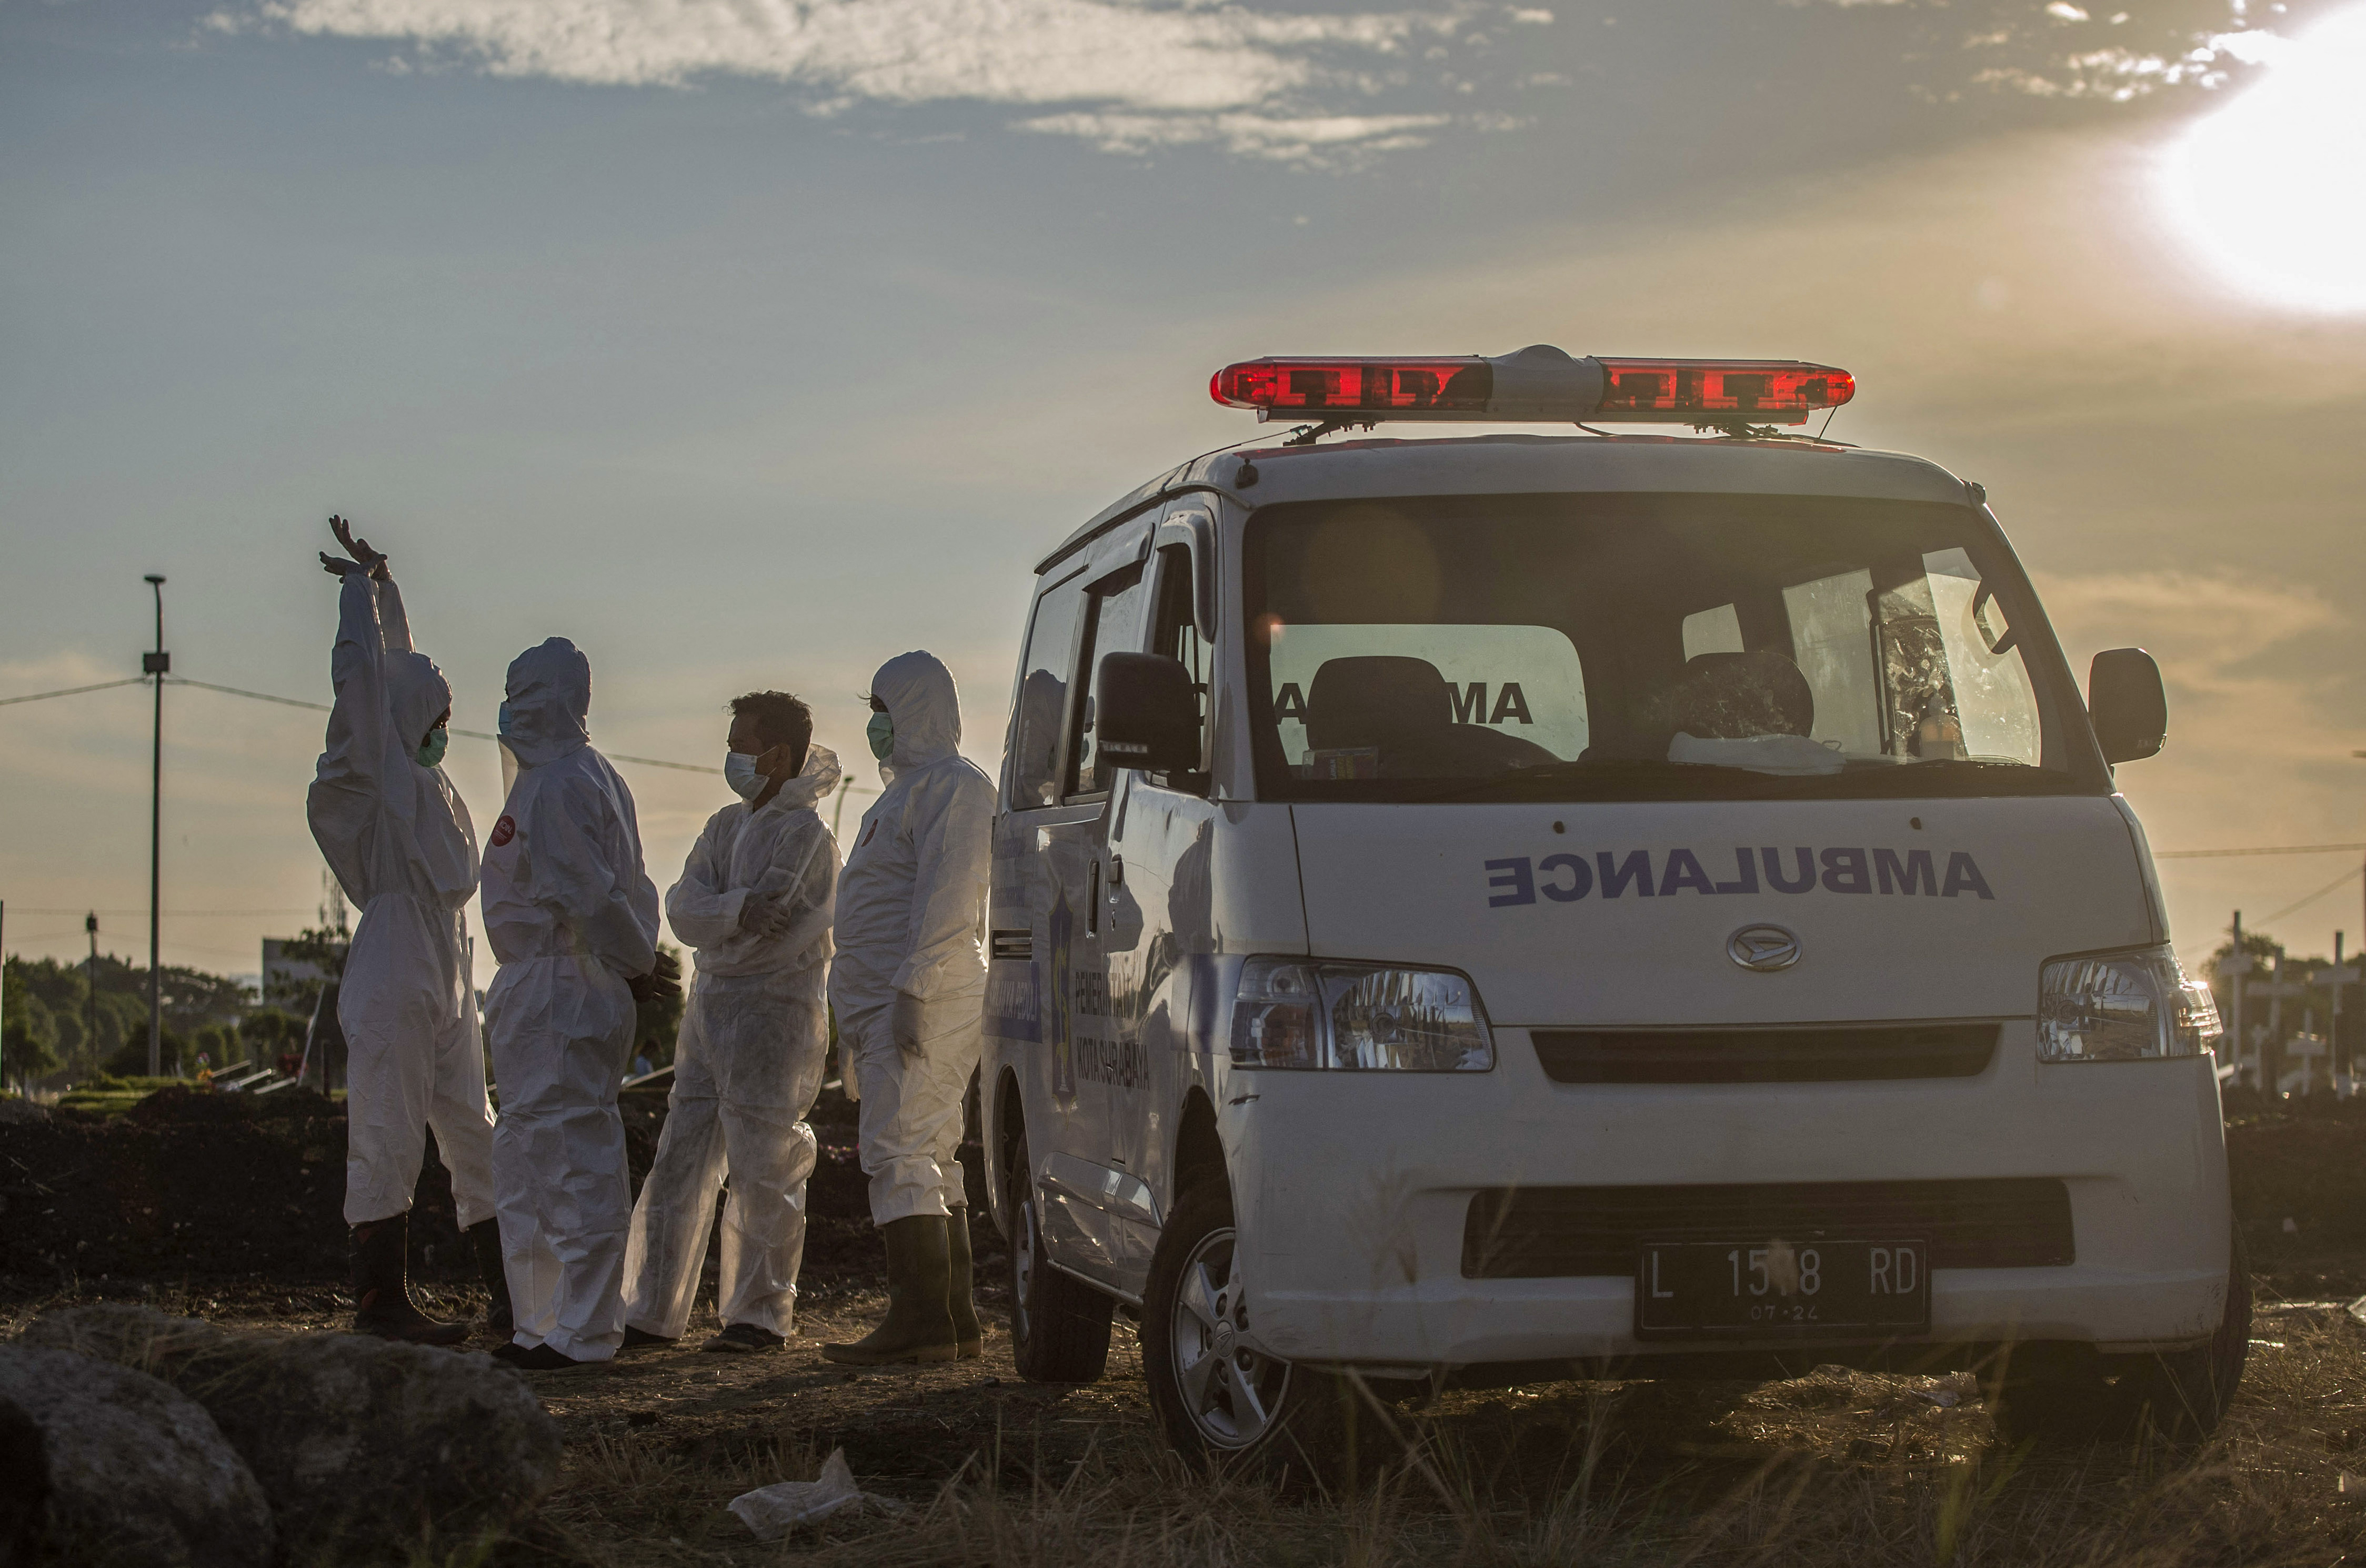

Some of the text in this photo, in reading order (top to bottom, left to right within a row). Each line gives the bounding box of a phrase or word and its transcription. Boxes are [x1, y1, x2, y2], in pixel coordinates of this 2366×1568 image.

[1075, 971, 1130, 1018] PEMERINTAH
[1077, 1036, 1150, 1091] KOTA SURABAYA
[1651, 1250, 1675, 1298] L
[1869, 1247, 1917, 1294] RD
